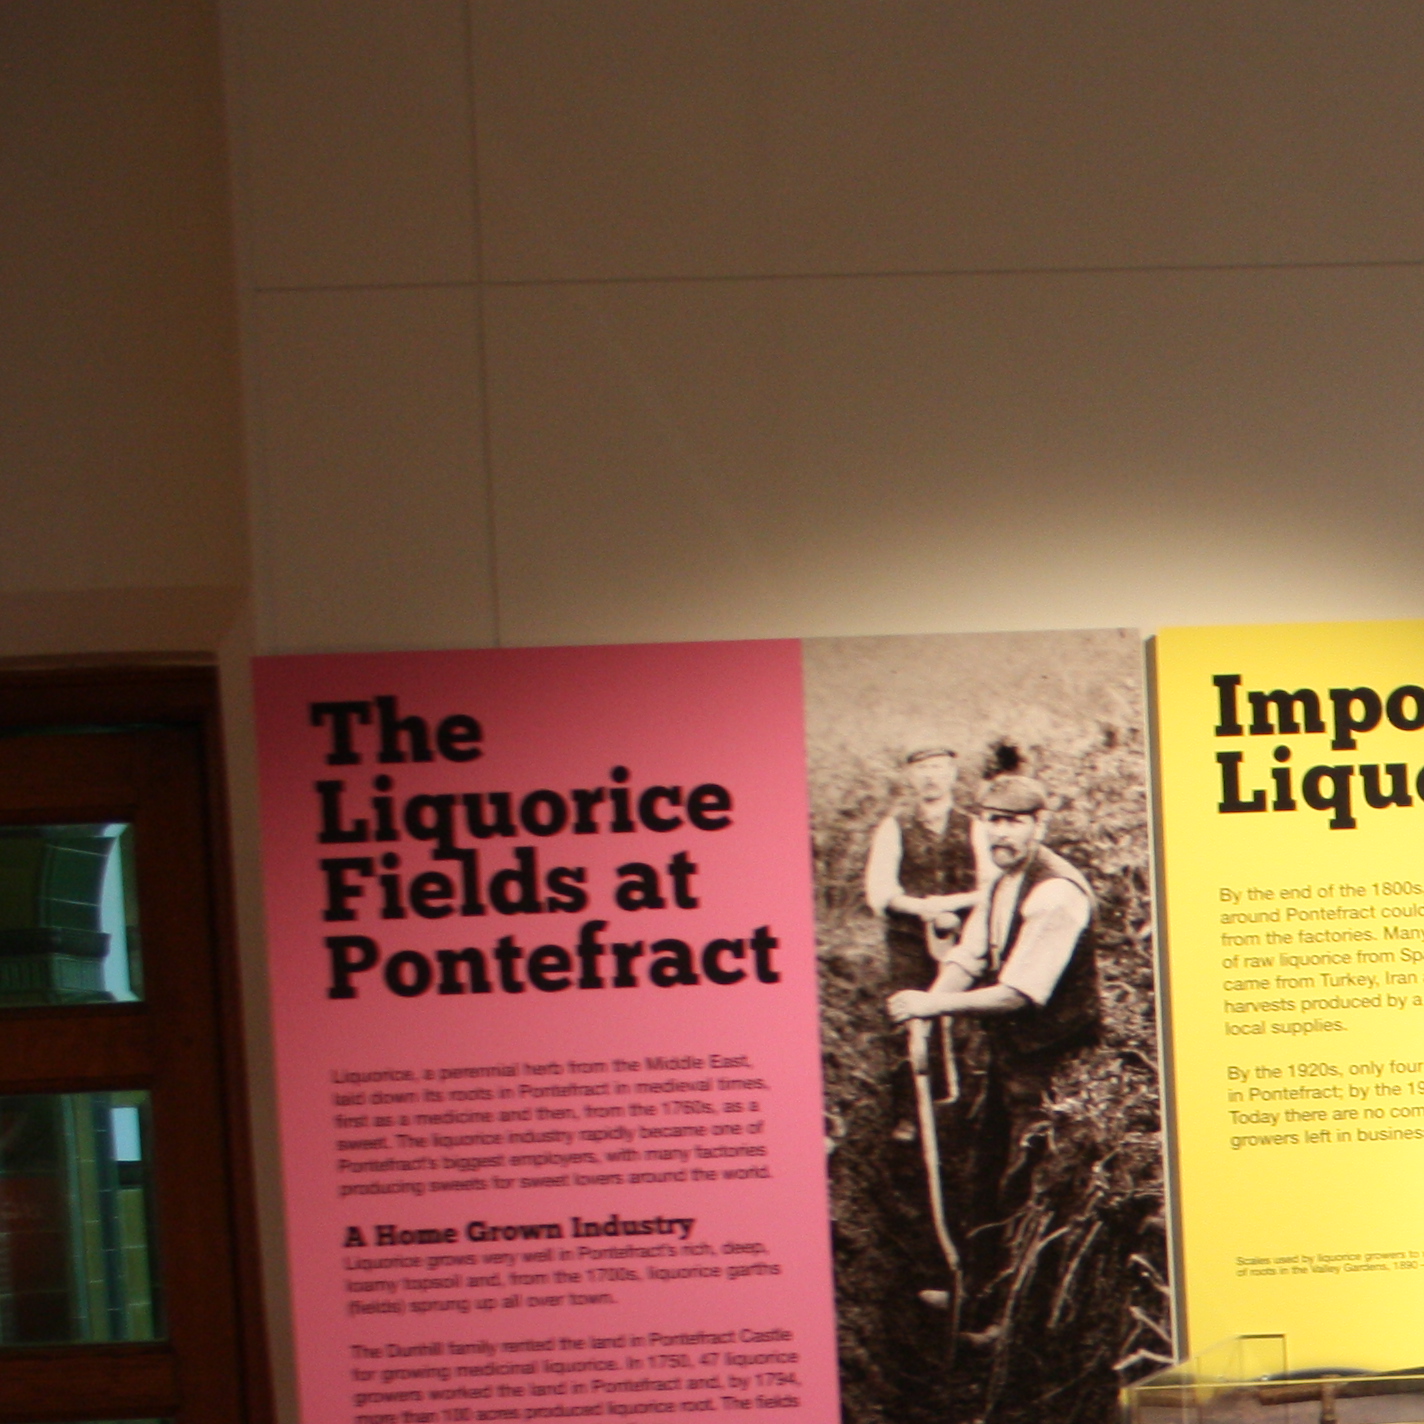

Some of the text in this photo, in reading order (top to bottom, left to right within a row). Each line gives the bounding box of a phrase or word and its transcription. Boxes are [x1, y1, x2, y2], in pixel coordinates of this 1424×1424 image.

[309, 695, 483, 765] The
[315, 765, 734, 860] Liquorice
[321, 846, 701, 921] Fields at
[1219, 887, 1241, 905] By
[1246, 887, 1274, 900] the
[1279, 884, 1311, 899] end
[1317, 883, 1333, 898] of
[1338, 883, 1366, 897] the
[324, 920, 781, 999] Pontefract
[1228, 1088, 1243, 1102] in
[1248, 1085, 1343, 1101] Pontefract;
[1349, 1083, 1369, 1100] by
[1374, 1082, 1401, 1096] the
[342, 1217, 695, 1248] A Home Grown Industry
